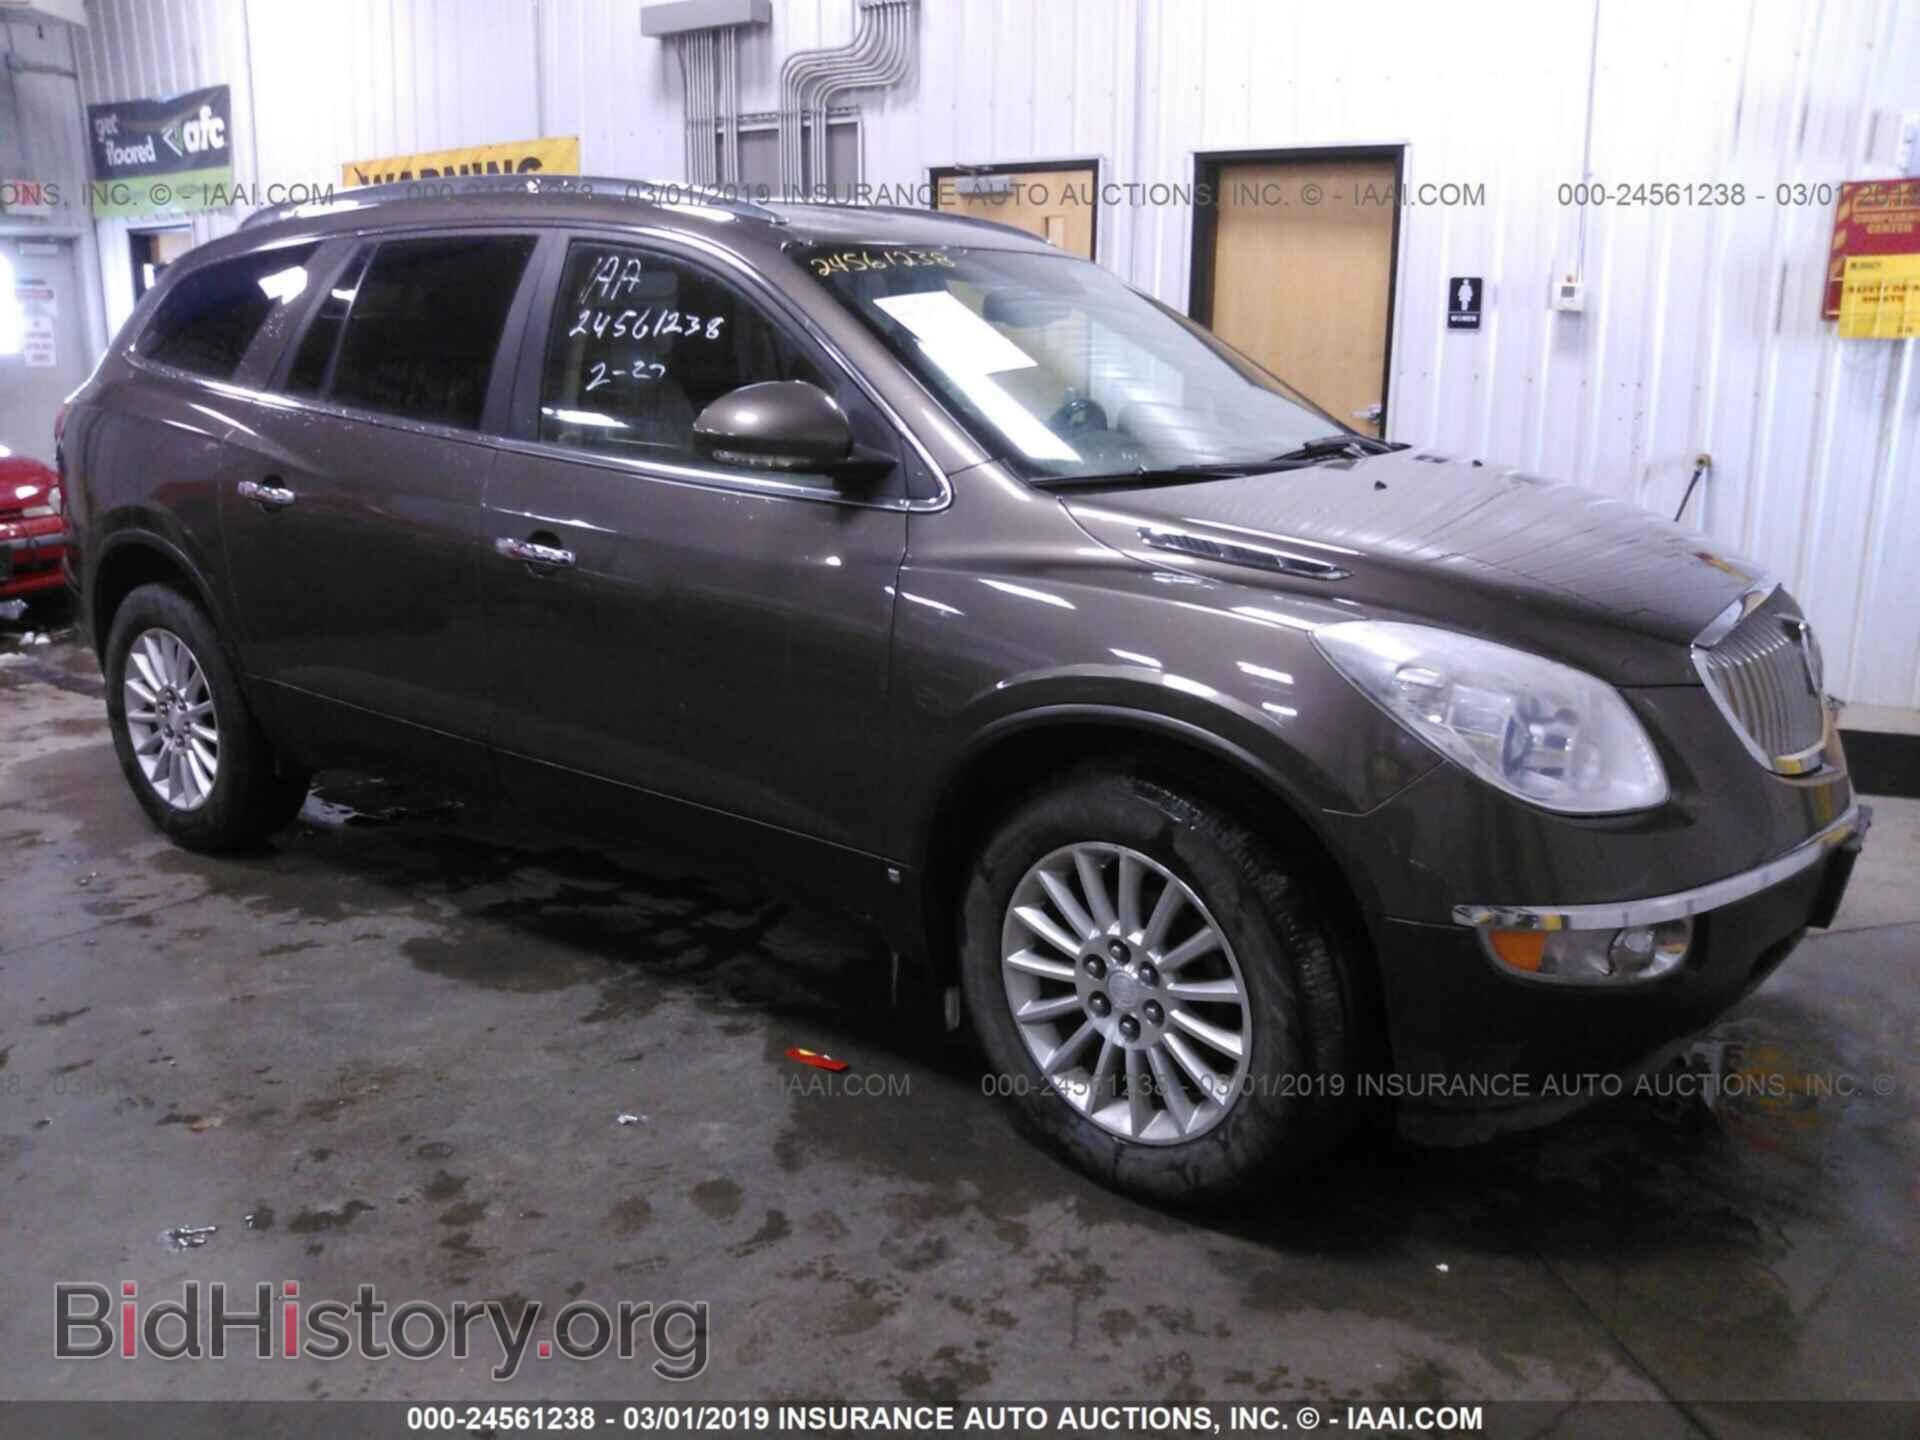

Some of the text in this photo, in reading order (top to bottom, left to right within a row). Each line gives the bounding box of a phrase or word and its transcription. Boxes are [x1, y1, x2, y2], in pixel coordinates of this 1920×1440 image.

[95, 113, 118, 142] get
[183, 105, 225, 152] afc
[106, 136, 157, 166] floored
[810, 250, 956, 277] 24561238
[569, 306, 725, 339] 24561238
